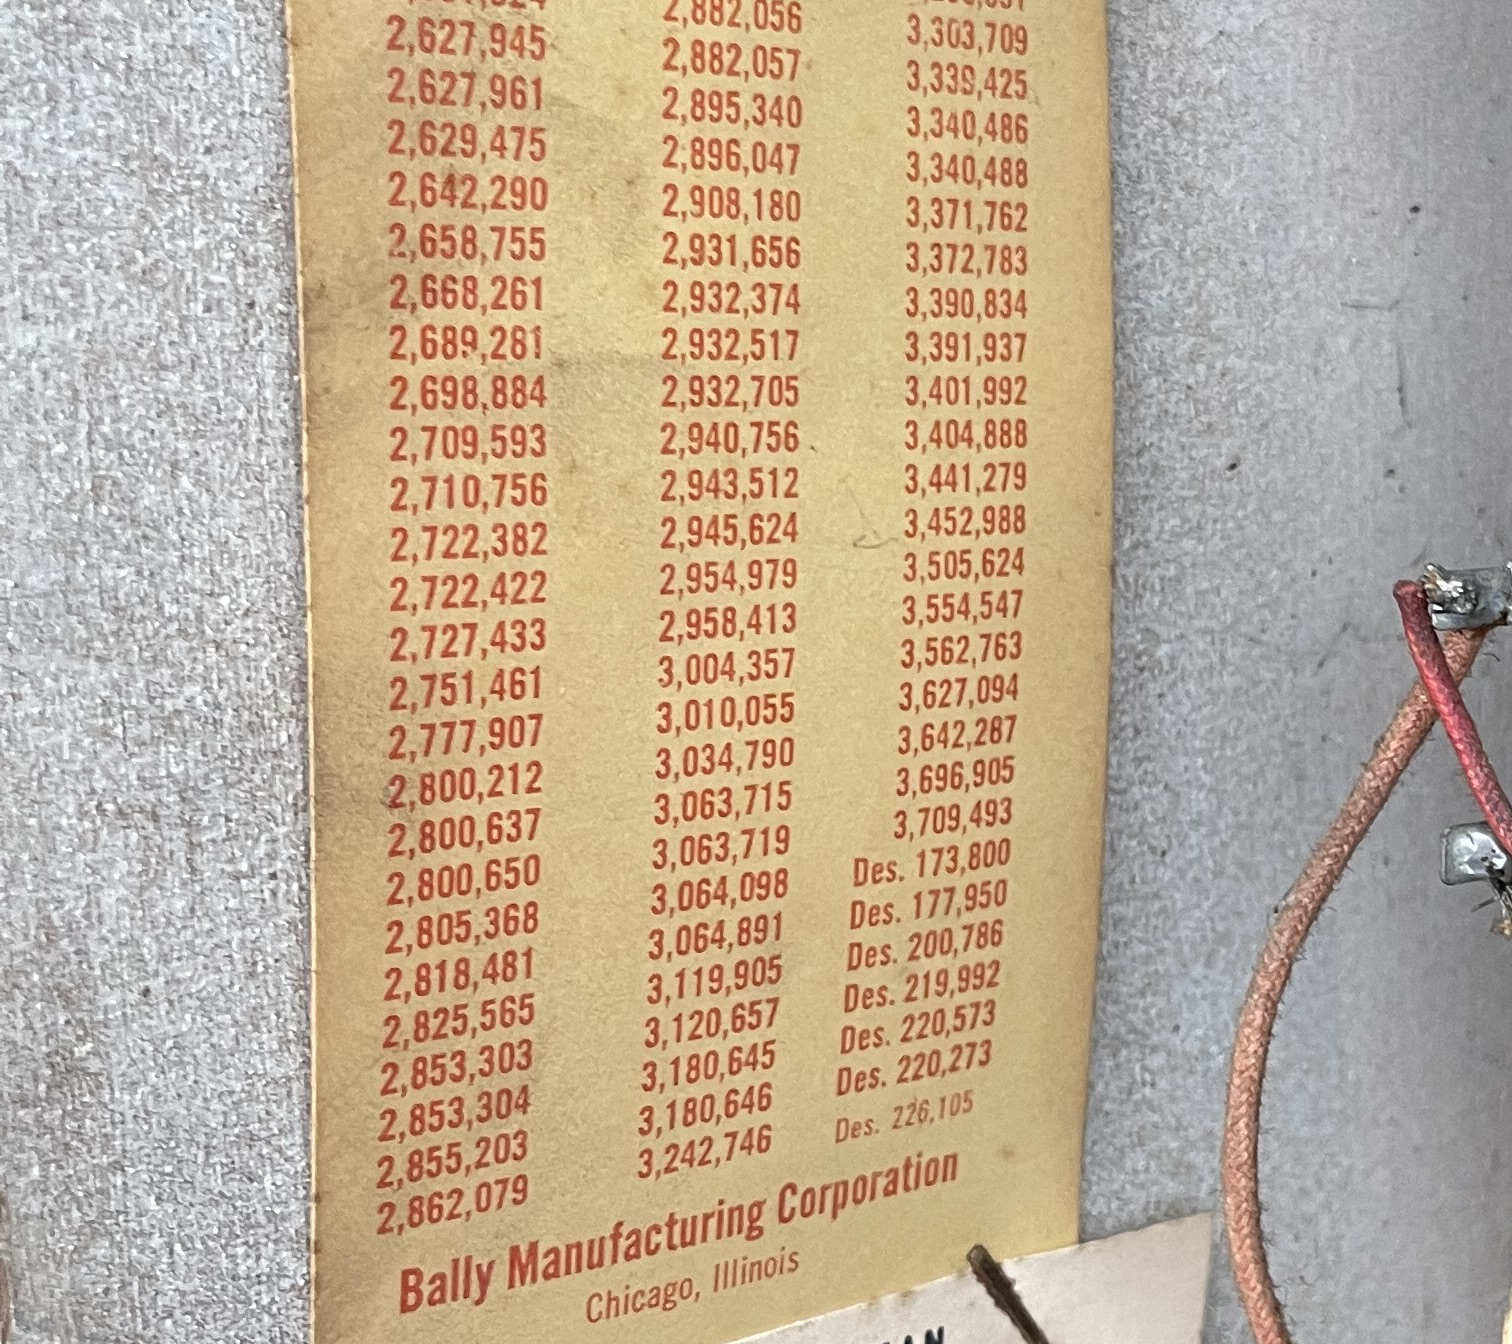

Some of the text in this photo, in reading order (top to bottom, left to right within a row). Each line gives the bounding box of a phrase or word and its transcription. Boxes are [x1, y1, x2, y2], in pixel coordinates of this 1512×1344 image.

[388, 67, 542, 110] 2,627,961
[907, 106, 1028, 144] 3,340,486
[662, 135, 800, 176] 2,896,047
[389, 171, 548, 212] 2,642,290
[906, 196, 1027, 234] 3,371,762
[663, 231, 800, 272] 2,931,656
[389, 324, 541, 365] 2,689,281
[905, 331, 1026, 365] 3,391,937
[662, 375, 799, 412] 2,932,705
[389, 424, 546, 465] 2,709,593
[905, 418, 1027, 453] 3,404,888
[661, 467, 798, 505] 2,943,512
[903, 547, 1024, 583] 3,505,624
[390, 570, 546, 616] 2,722,422
[659, 602, 796, 645] 2,958,413
[901, 631, 1022, 672] 3,562,763
[390, 665, 540, 714] 2,751,461
[656, 692, 794, 737] 3,010,055
[896, 755, 1014, 798] 3,696,905
[388, 808, 541, 860] 2,800,637
[652, 825, 790, 872] 3,063,719
[854, 838, 1010, 887] Des. 173,800
[385, 901, 538, 956] 2,805,368
[648, 911, 783, 961] 3,064,891
[847, 919, 1003, 971] Des. 200,786
[841, 999, 996, 1054] Des. 220,573
[381, 1039, 532, 1097] 2,853,303
[641, 1040, 776, 1093] 3,180,645
[835, 1089, 973, 1144] Des. 226,105
[376, 1130, 528, 1190] 2,855,203
[638, 1124, 772, 1180] 3,242,746
[400, 1152, 958, 1314] Bally Manufacturing Corporation
[586, 1252, 799, 1323] Chicago, Illinois
